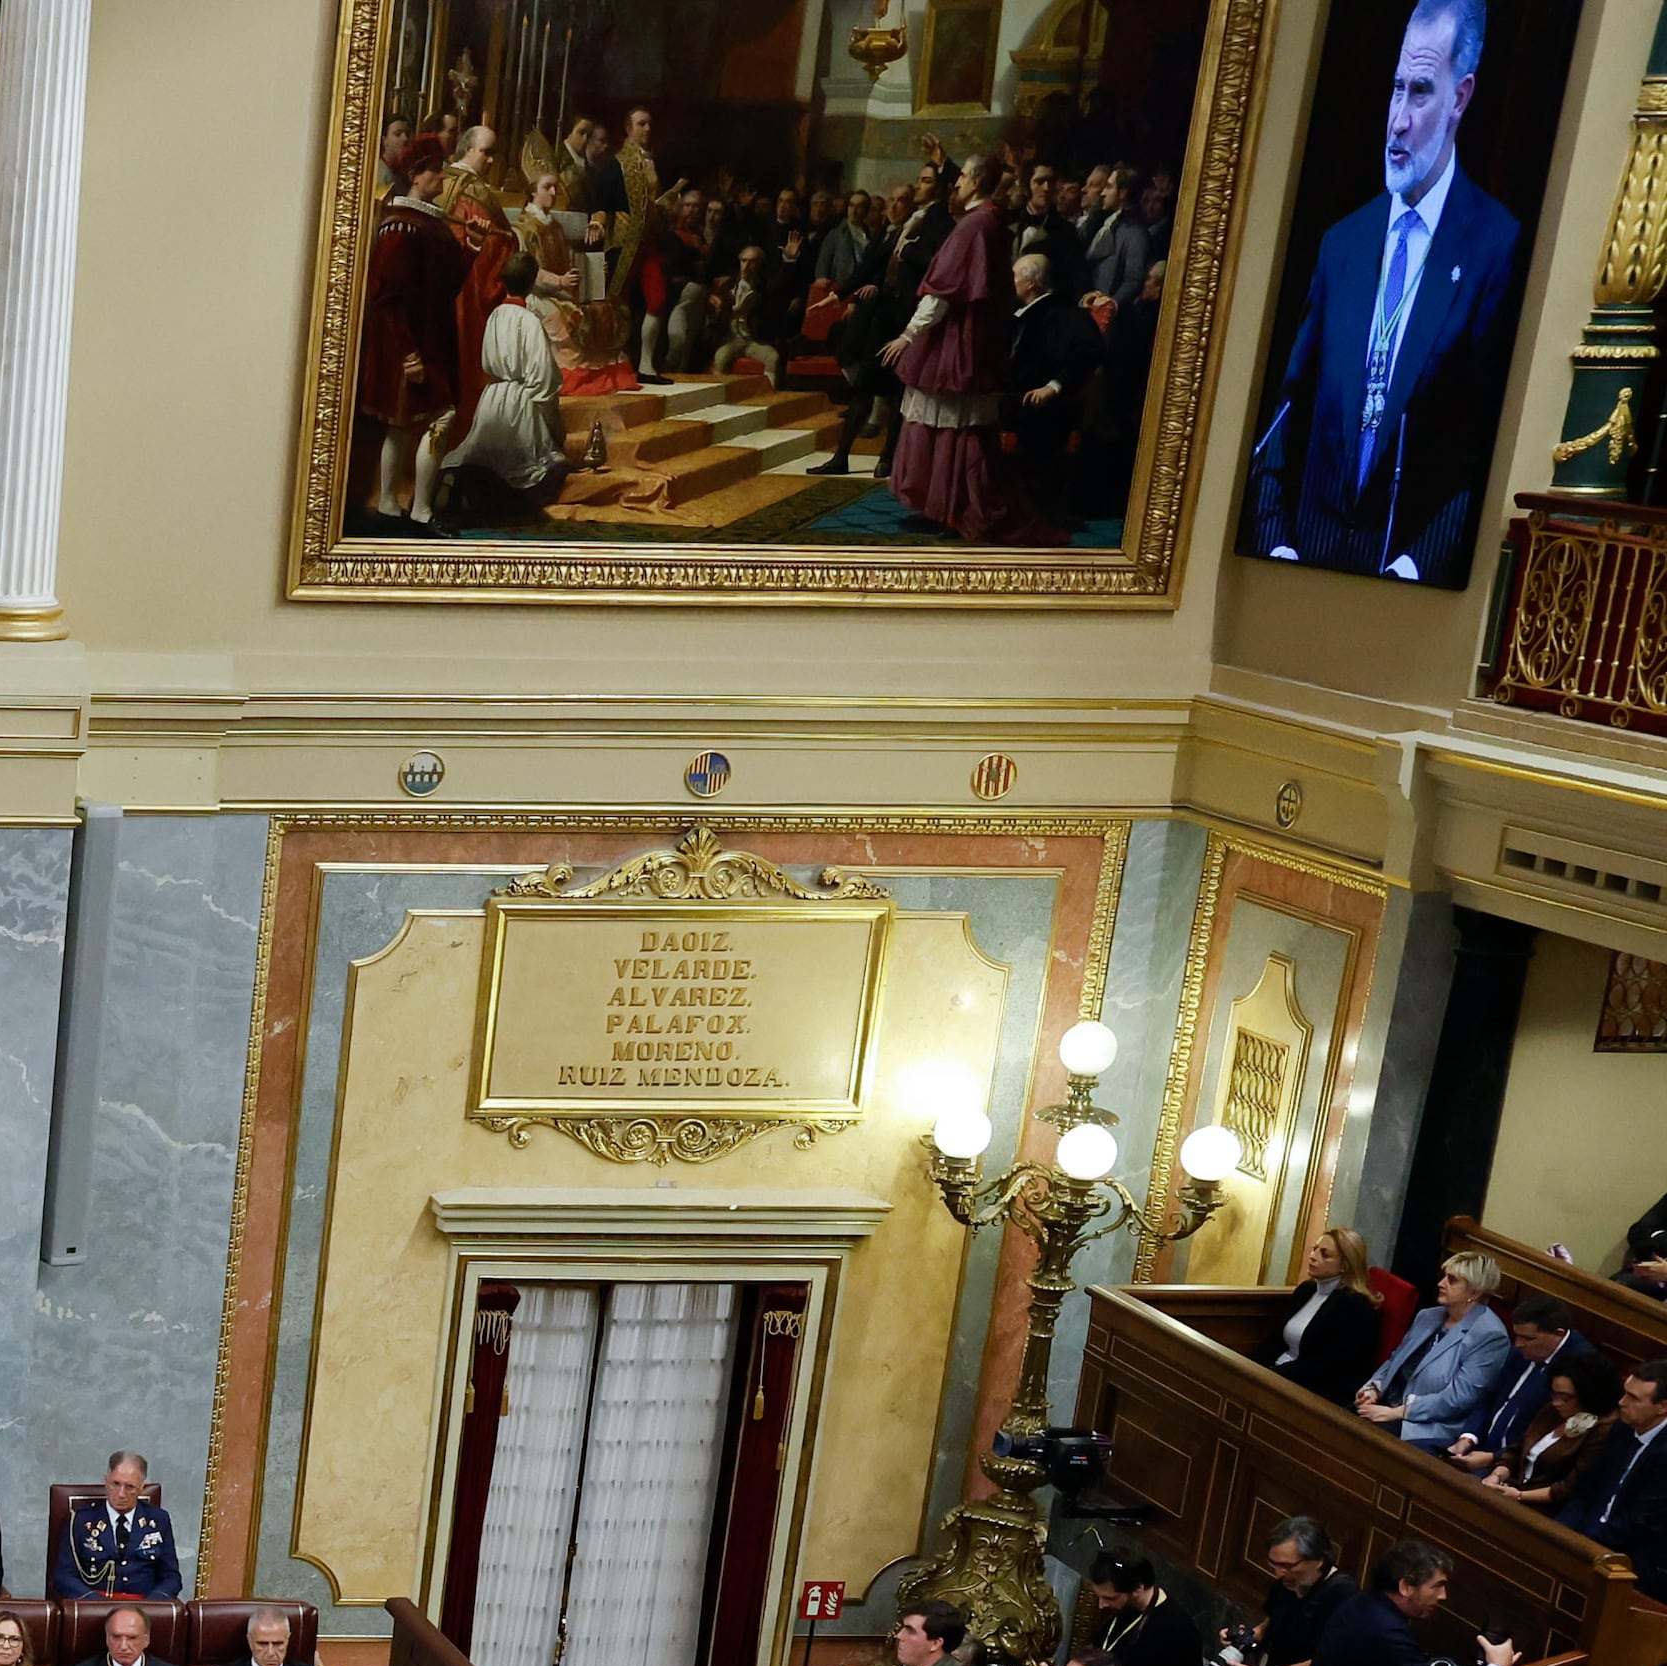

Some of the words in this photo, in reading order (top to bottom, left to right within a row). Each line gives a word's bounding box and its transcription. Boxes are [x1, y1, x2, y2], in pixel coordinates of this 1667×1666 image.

[639, 931, 734, 952] DAOIZ.
[613, 958, 757, 980] VELARDE.
[607, 986, 753, 1007] ALVAREZ.
[605, 1013, 751, 1034] PALAFOX.
[611, 1040, 740, 1061] MORENO.
[558, 1065, 627, 1086] RUIZ
[637, 1066, 790, 1087] MENDOZA.
